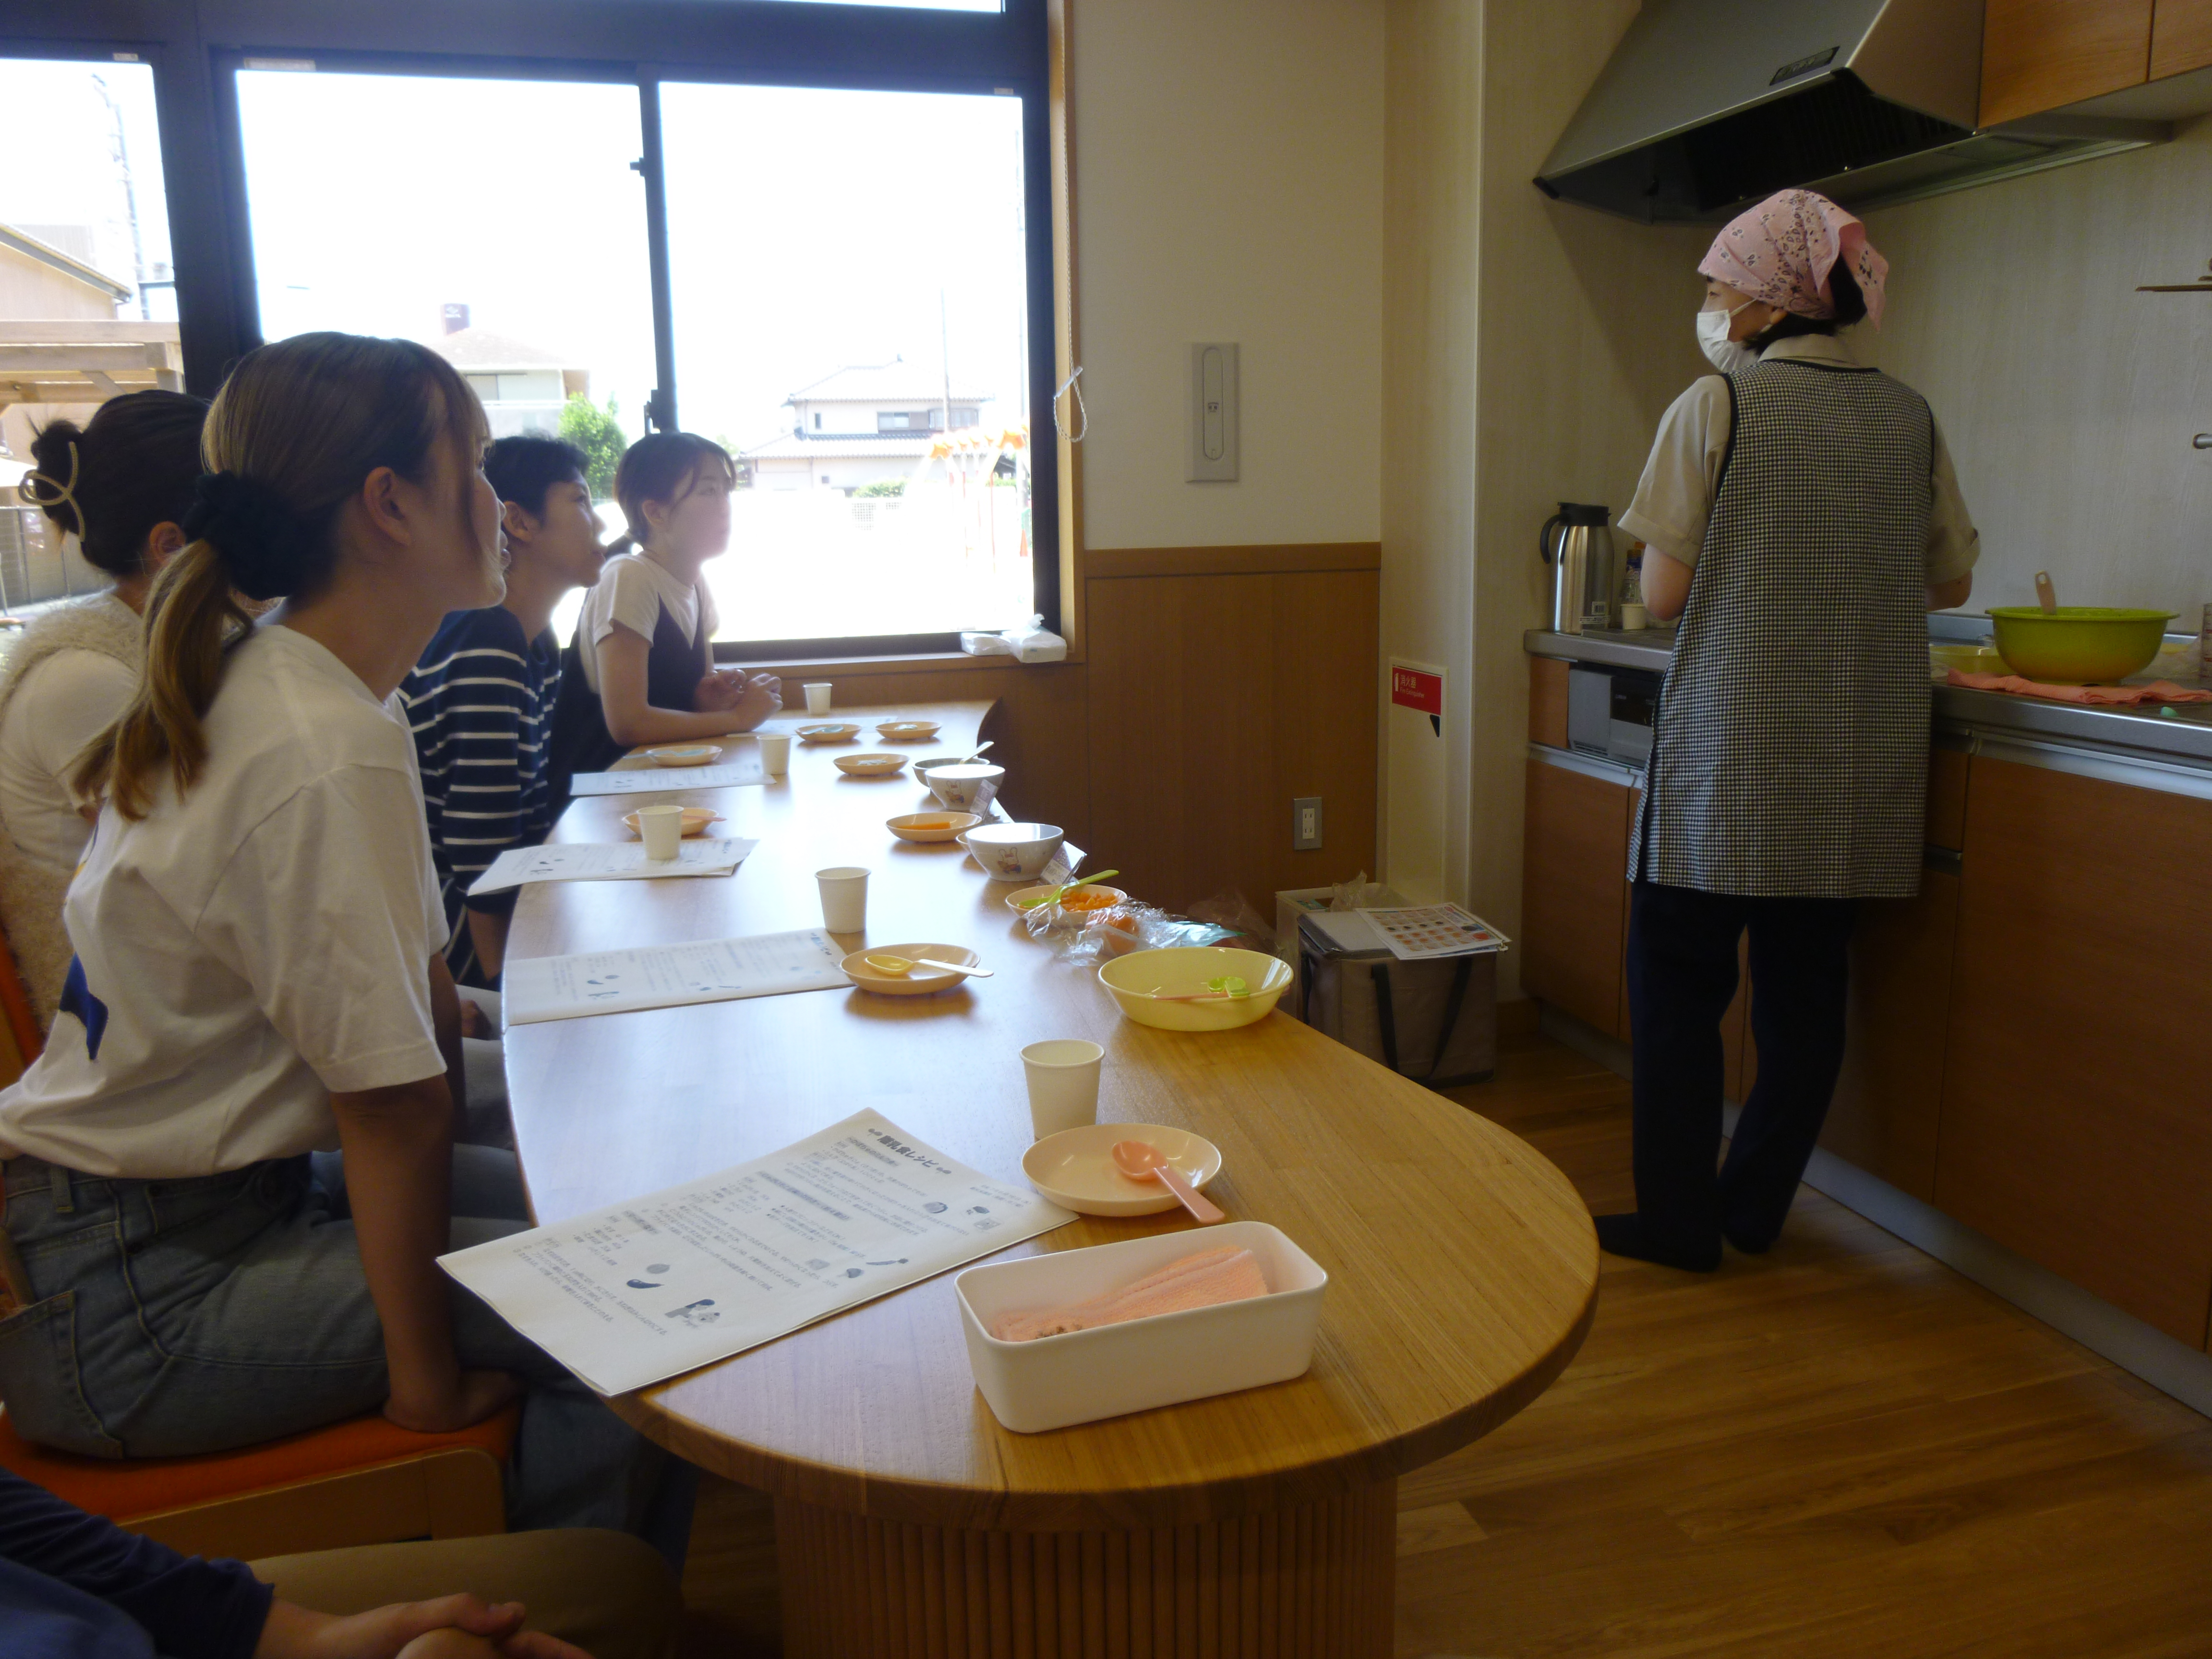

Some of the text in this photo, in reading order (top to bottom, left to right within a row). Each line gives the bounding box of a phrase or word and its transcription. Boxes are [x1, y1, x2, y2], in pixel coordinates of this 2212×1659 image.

[1400, 674, 1416, 688] 消火器
[877, 1135, 939, 1167] 離乳食レシピ
